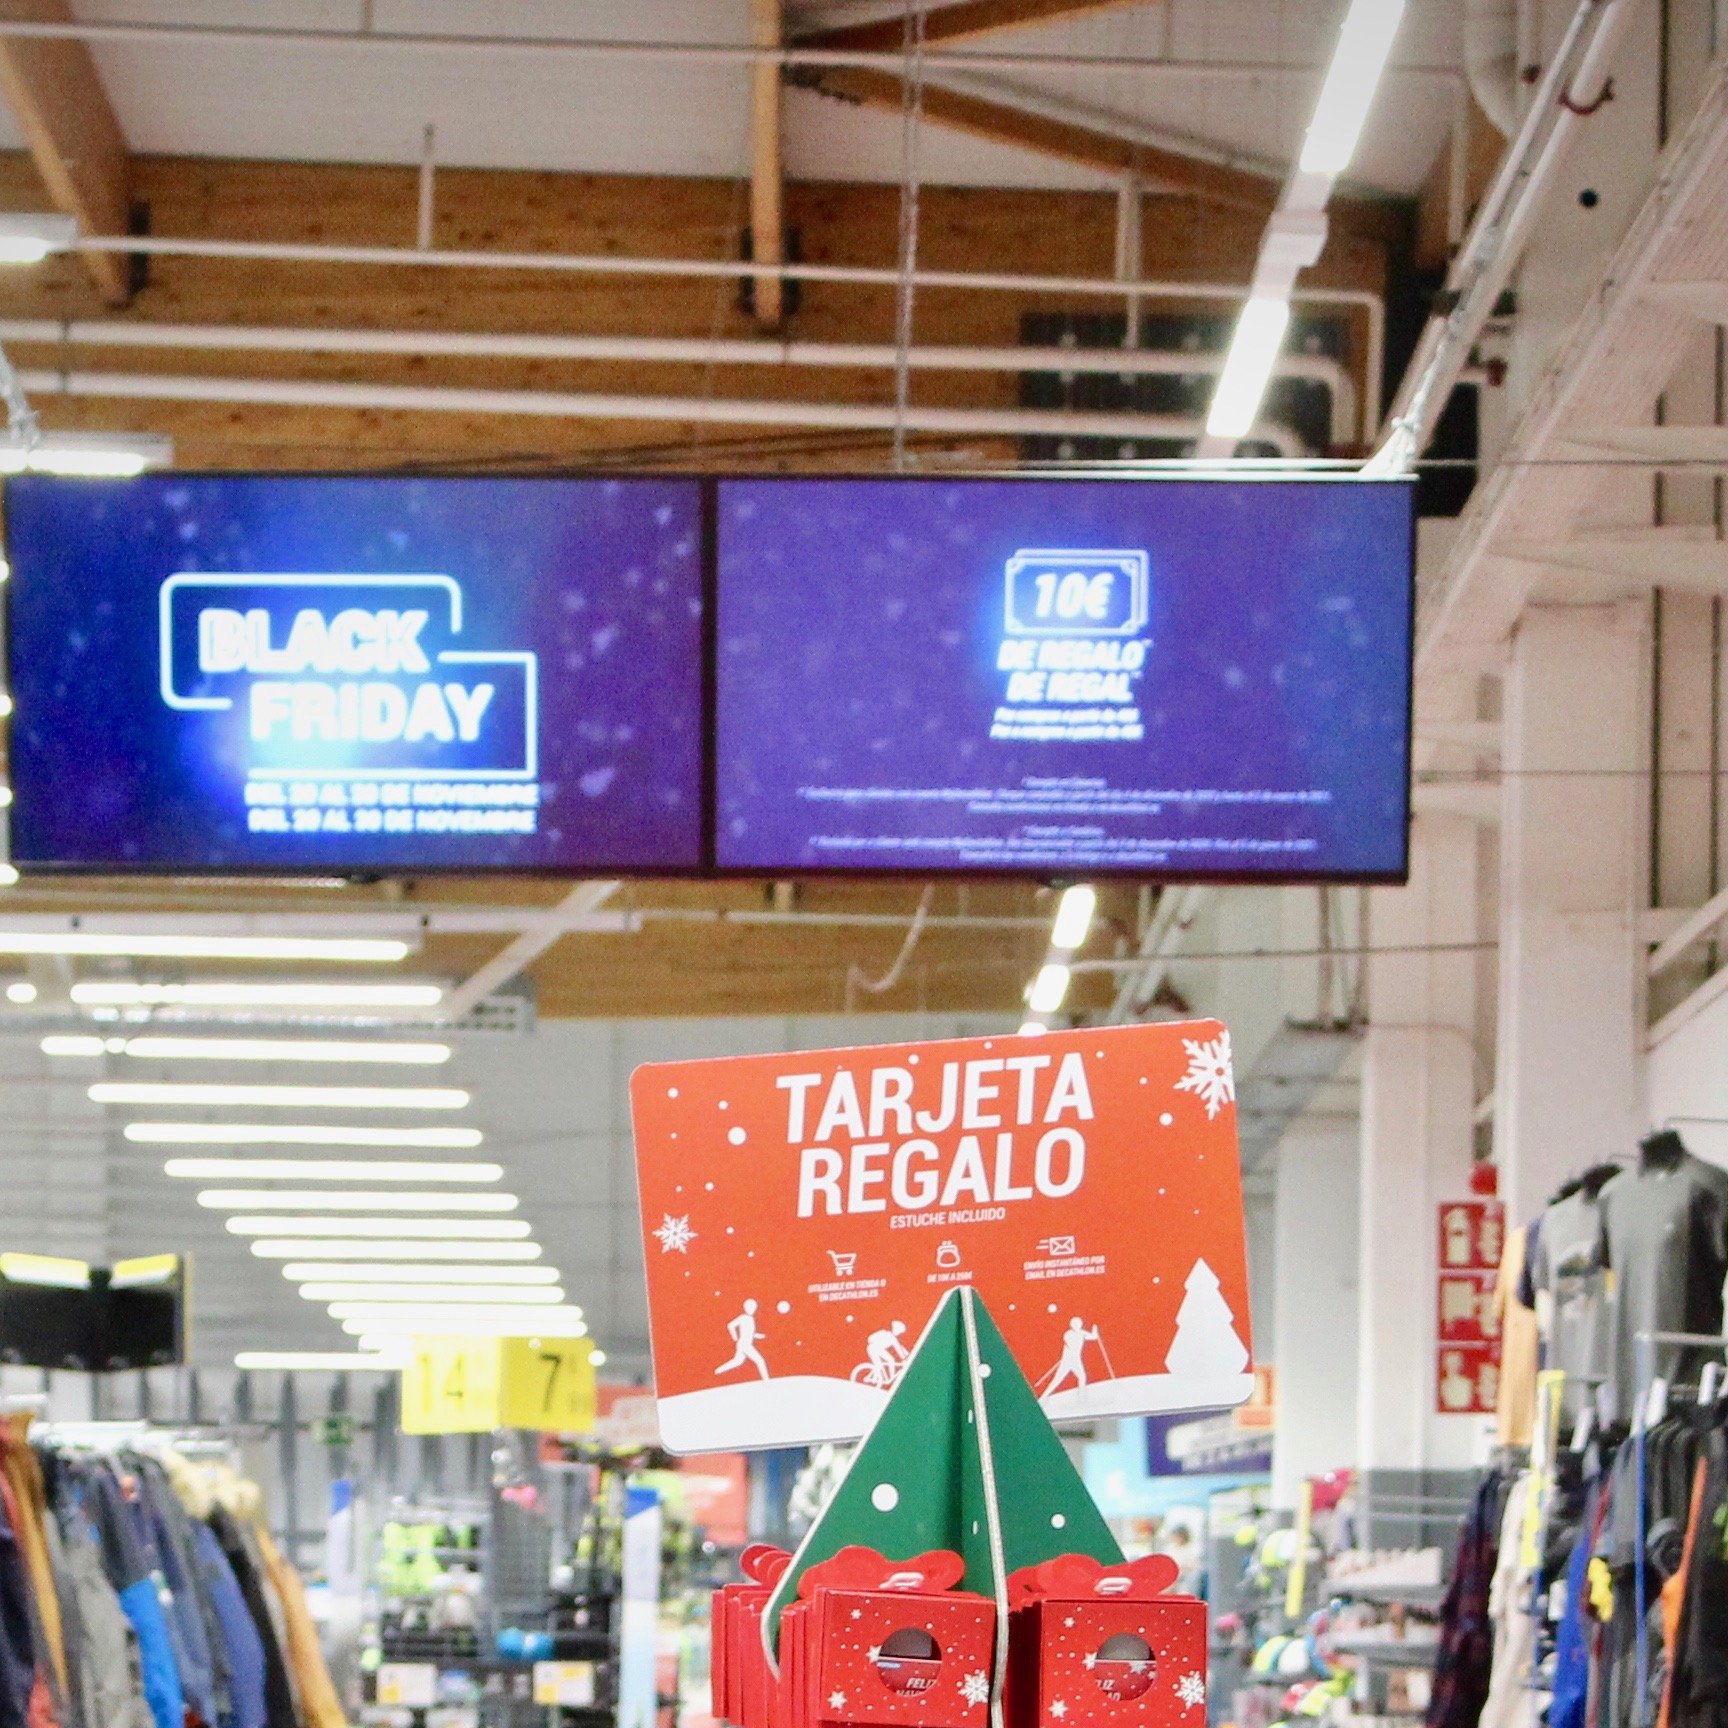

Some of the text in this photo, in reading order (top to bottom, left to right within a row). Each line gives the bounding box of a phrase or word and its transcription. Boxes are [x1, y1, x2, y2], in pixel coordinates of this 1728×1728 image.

[1035, 571, 1115, 619] 10€
[198, 608, 431, 674] BLACK
[997, 639, 1037, 671] DE
[249, 681, 495, 743] FRIDAY
[1006, 671, 1048, 702] DE
[776, 1052, 1095, 1144] TARJETA
[797, 1128, 1087, 1218] REGALO
[889, 1207, 1006, 1229] ESTUCHE INCLUIDO
[539, 1353, 562, 1412] 7
